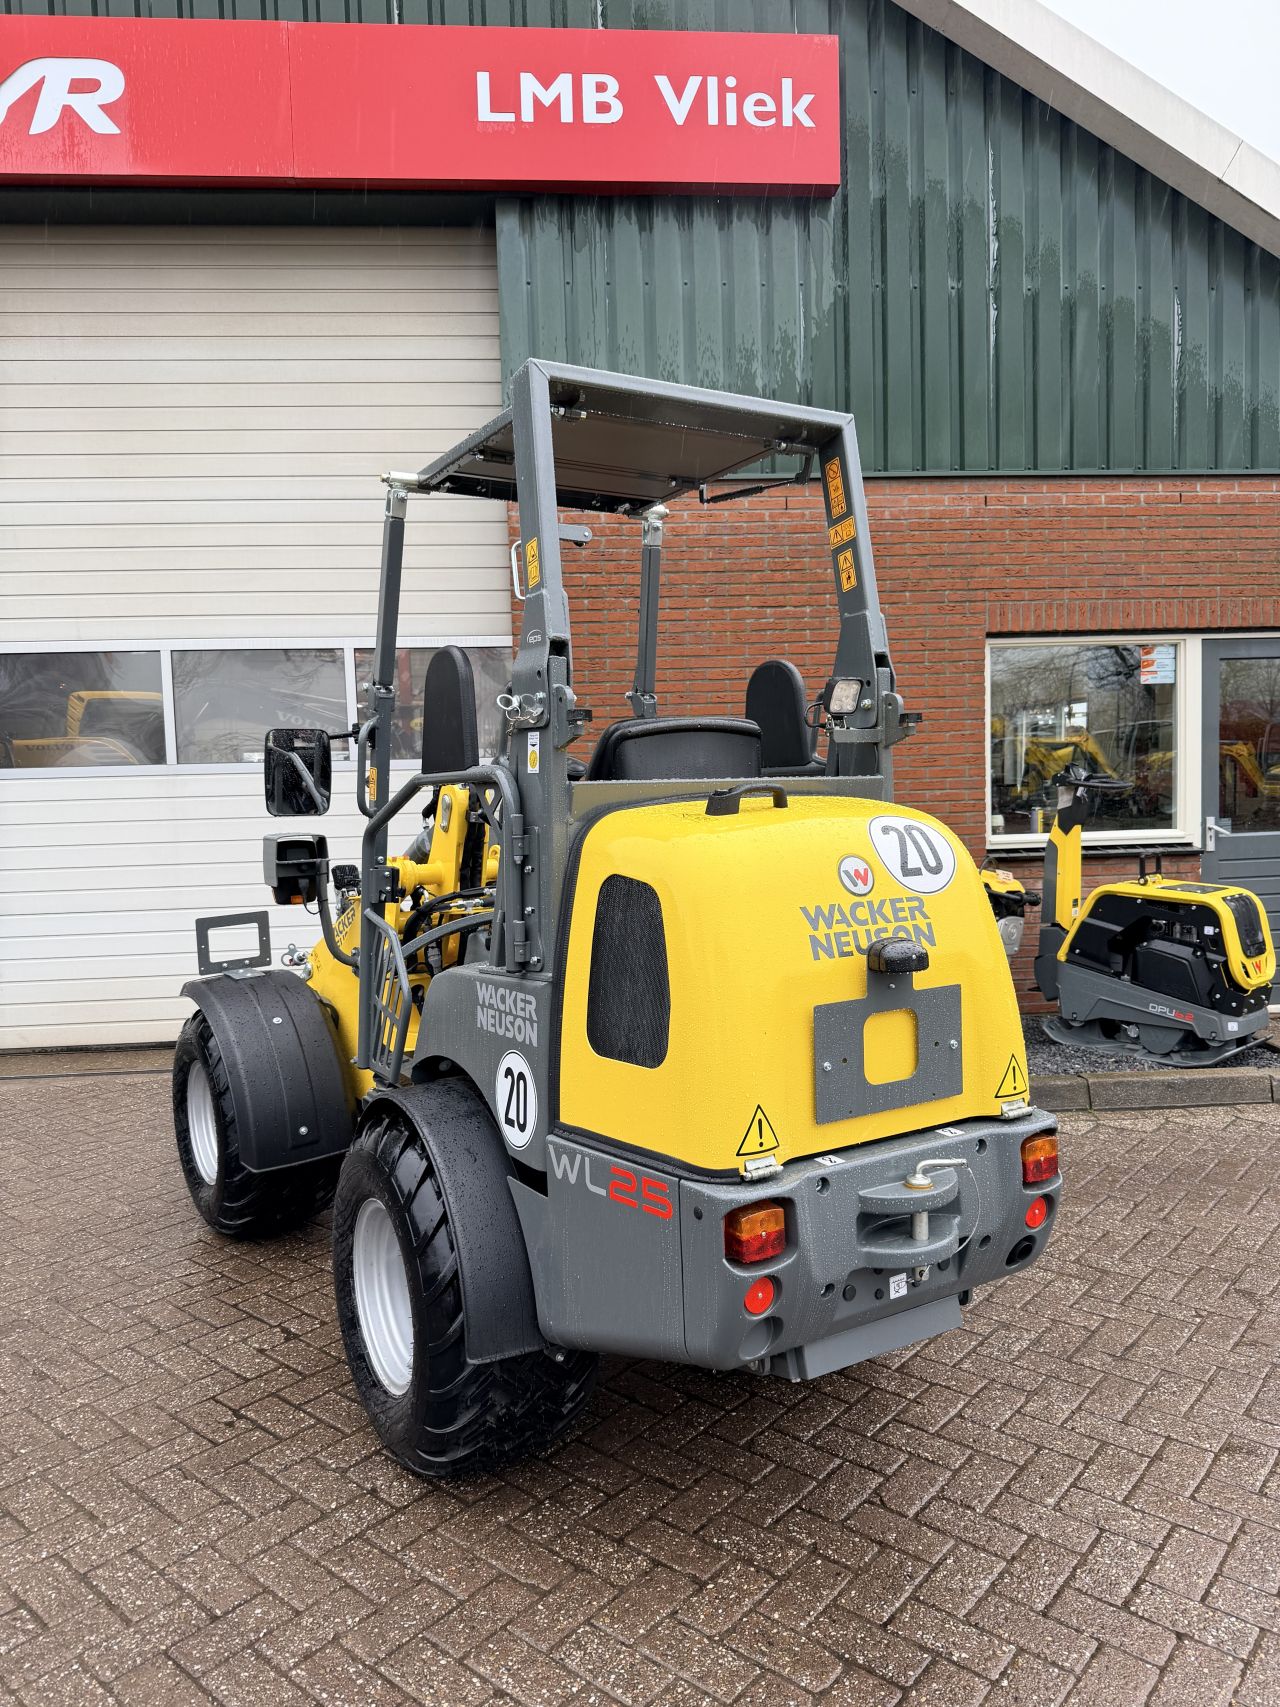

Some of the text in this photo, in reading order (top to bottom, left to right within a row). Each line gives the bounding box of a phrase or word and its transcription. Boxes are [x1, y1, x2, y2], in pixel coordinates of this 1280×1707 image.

[476, 71, 817, 127] LMB Vliek
[881, 824, 944, 877] 20
[334, 906, 356, 938] ACKER
[800, 896, 932, 932] WACKER
[476, 981, 538, 1020] WACKER
[477, 1005, 538, 1047] NEUSON
[504, 1066, 528, 1133] 20
